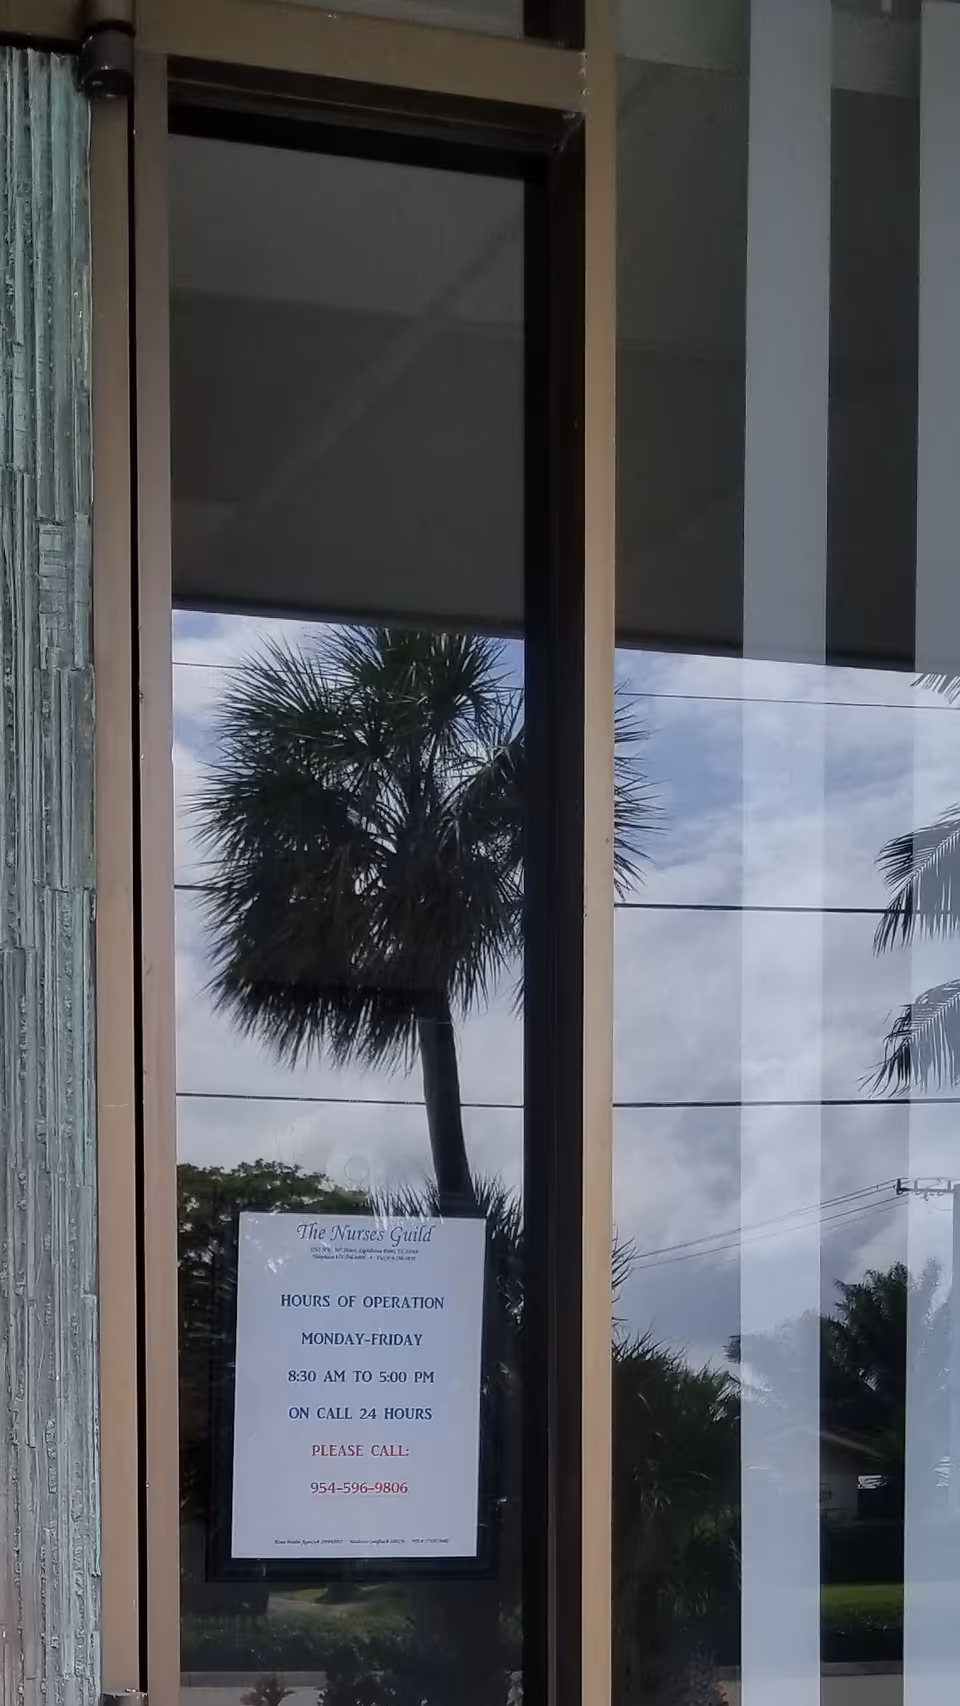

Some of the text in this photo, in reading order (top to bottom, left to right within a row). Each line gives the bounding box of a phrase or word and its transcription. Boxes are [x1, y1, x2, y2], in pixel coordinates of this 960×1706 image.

[296, 1222, 435, 1247] The Nurses Guild
[280, 1294, 445, 1309] HOURS OF OPERATION
[301, 1332, 423, 1346] MONDAY-FRIDAY
[288, 1370, 435, 1384] 8:30 AM TO 5:00 PM
[288, 1407, 433, 1421] ON CALL 24 HOURS
[311, 1445, 410, 1457] PLEASE CALL:
[310, 1482, 408, 1495] 954-596-9806
